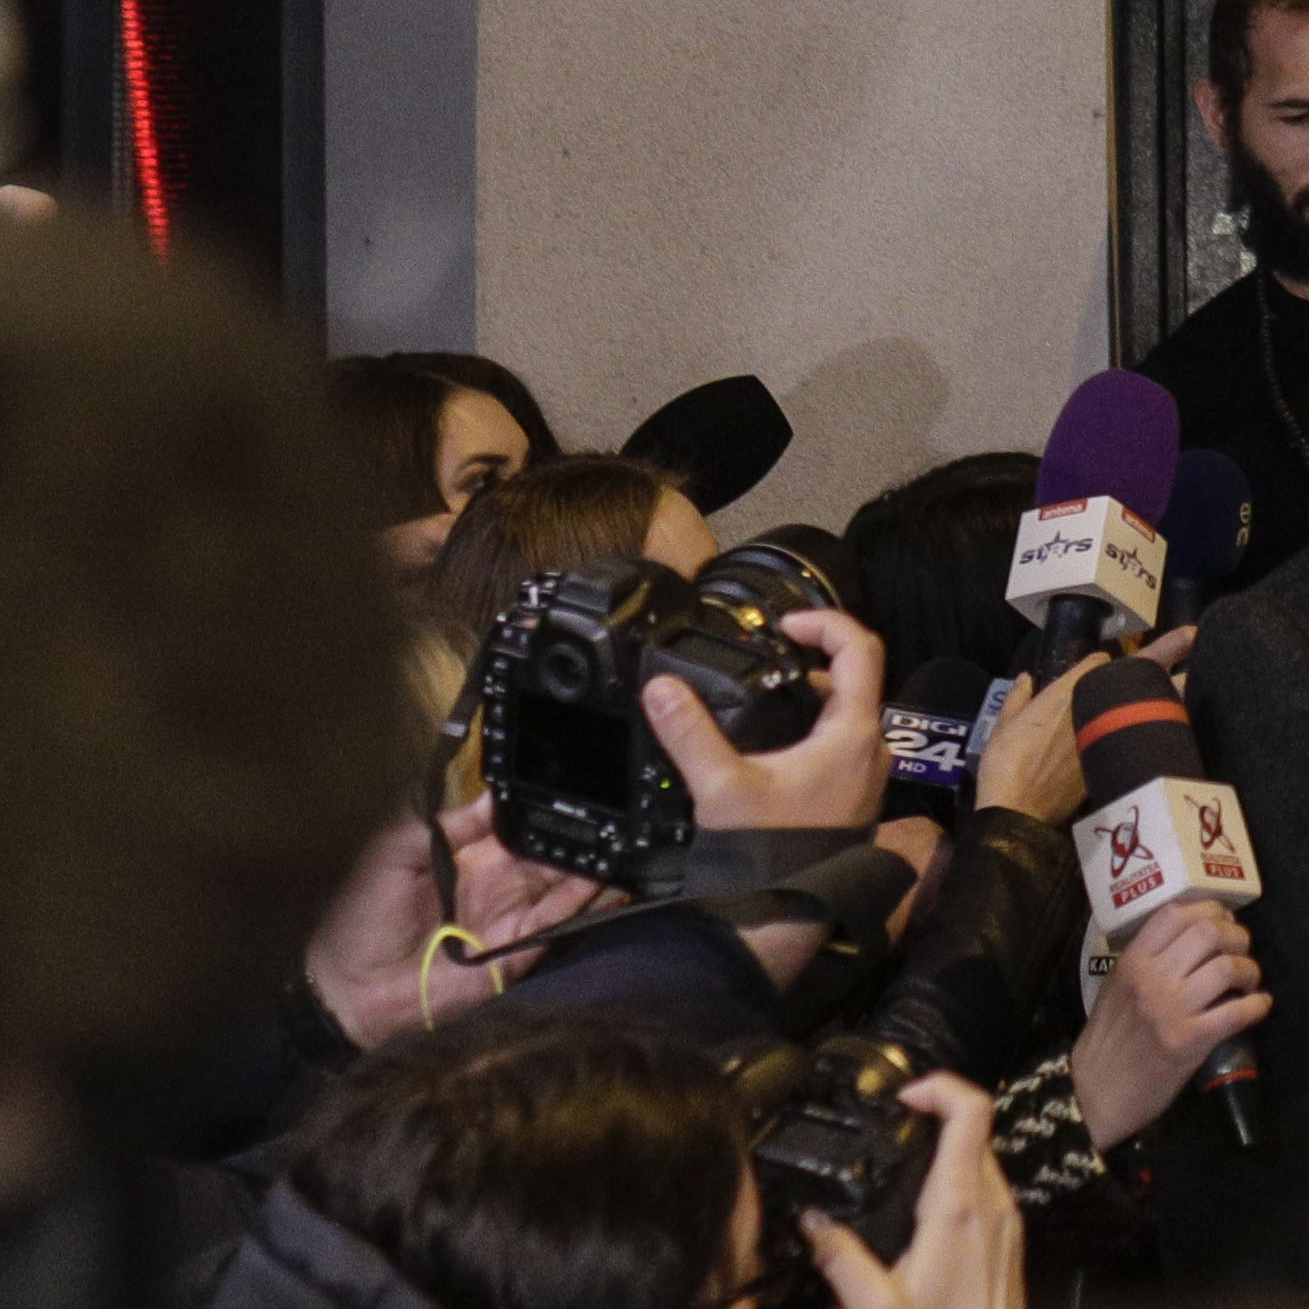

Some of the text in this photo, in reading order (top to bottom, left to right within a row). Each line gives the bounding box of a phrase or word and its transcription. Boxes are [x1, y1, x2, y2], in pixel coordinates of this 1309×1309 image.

[890, 713, 967, 738] DIGI
[884, 729, 967, 772] 24
[898, 759, 927, 773] HD
